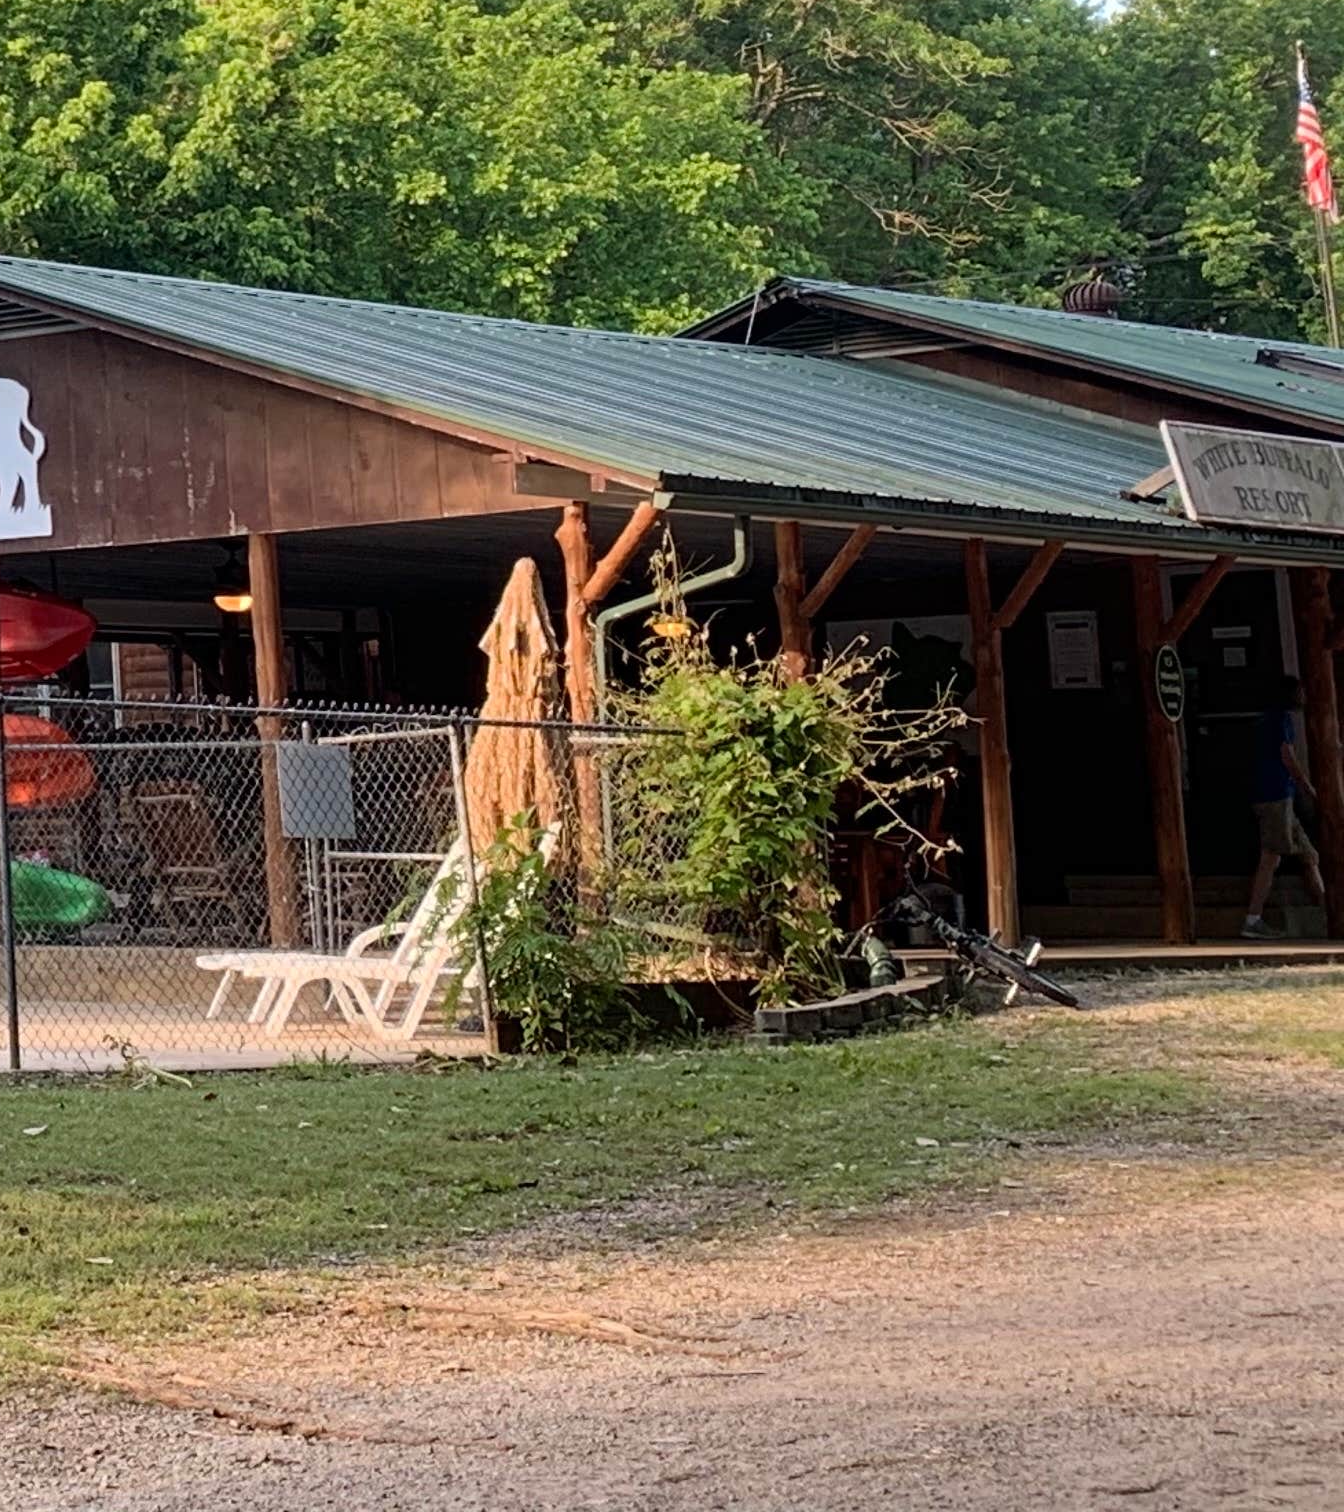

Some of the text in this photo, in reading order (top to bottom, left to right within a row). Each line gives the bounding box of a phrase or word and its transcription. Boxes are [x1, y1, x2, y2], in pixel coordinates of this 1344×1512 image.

[1193, 440, 1330, 489] WHITE BUFFALO
[1234, 486, 1312, 517] RESORT
